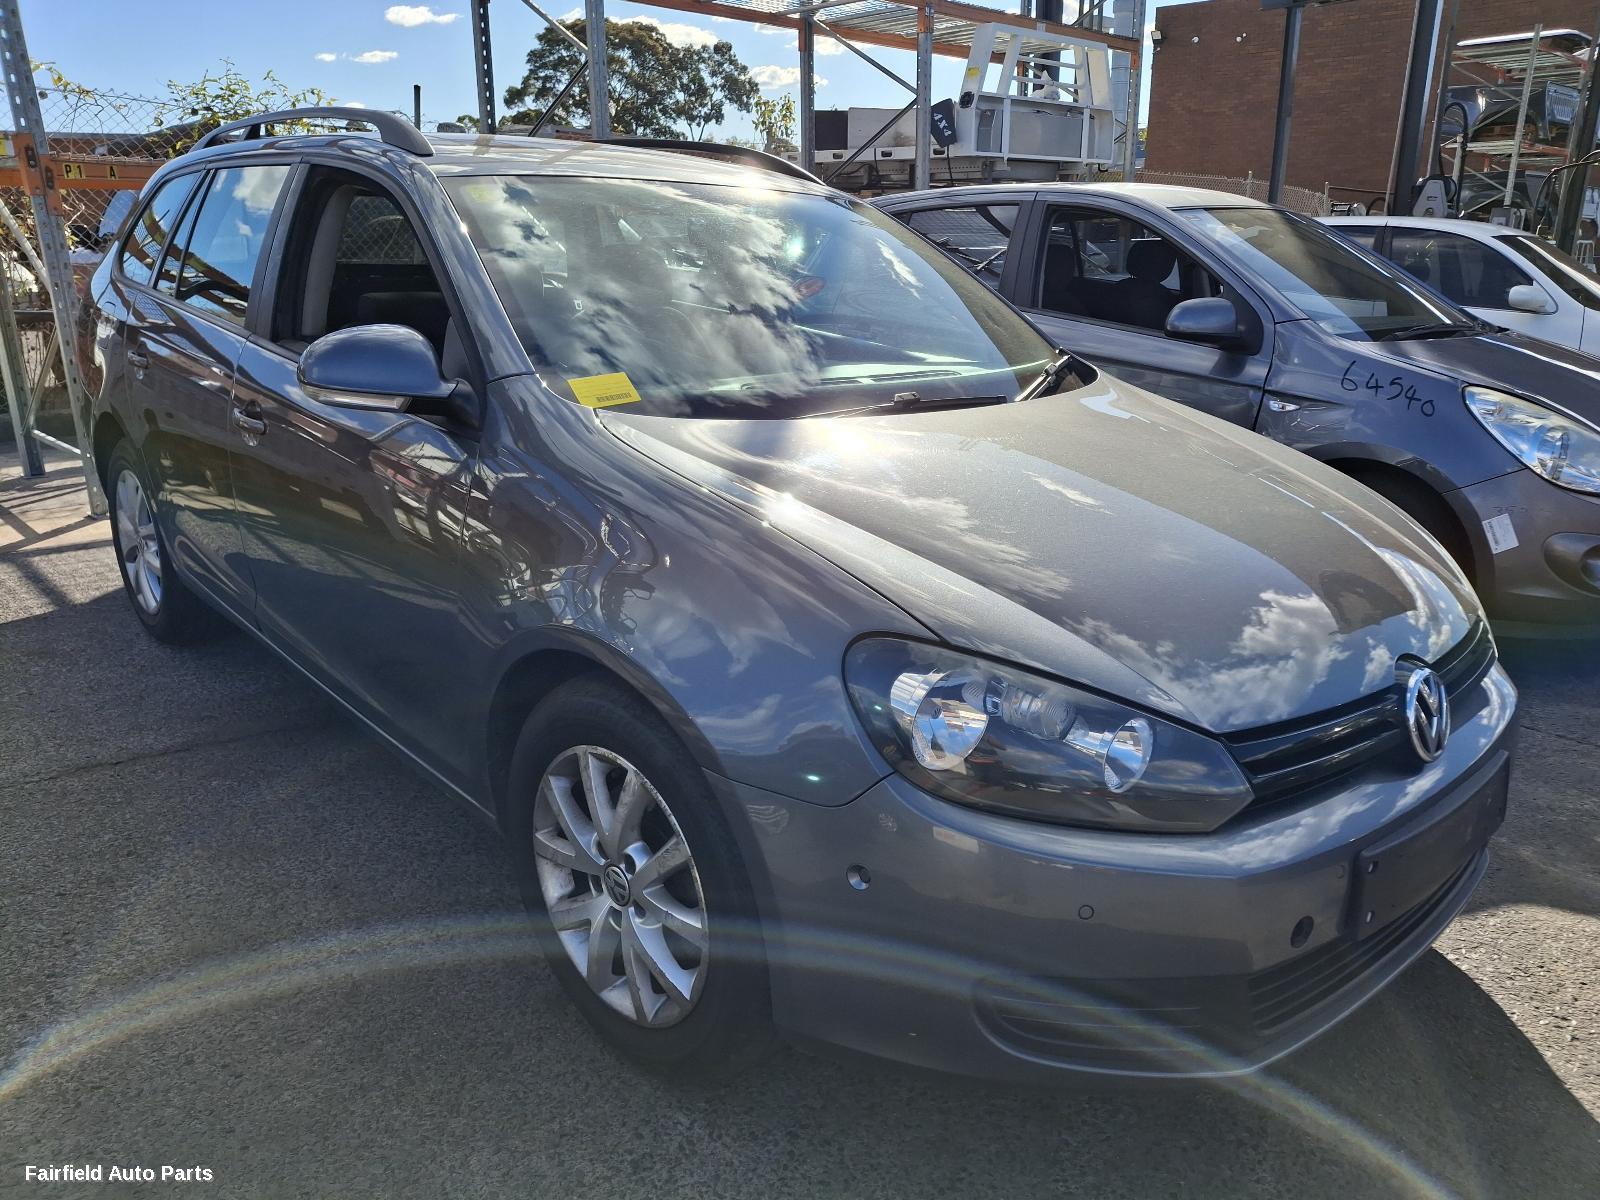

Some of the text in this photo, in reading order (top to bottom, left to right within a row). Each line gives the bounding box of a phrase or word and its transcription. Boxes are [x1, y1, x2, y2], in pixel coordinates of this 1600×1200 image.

[64, 163, 117, 179] P1 A
[1340, 360, 1436, 418] 64540
